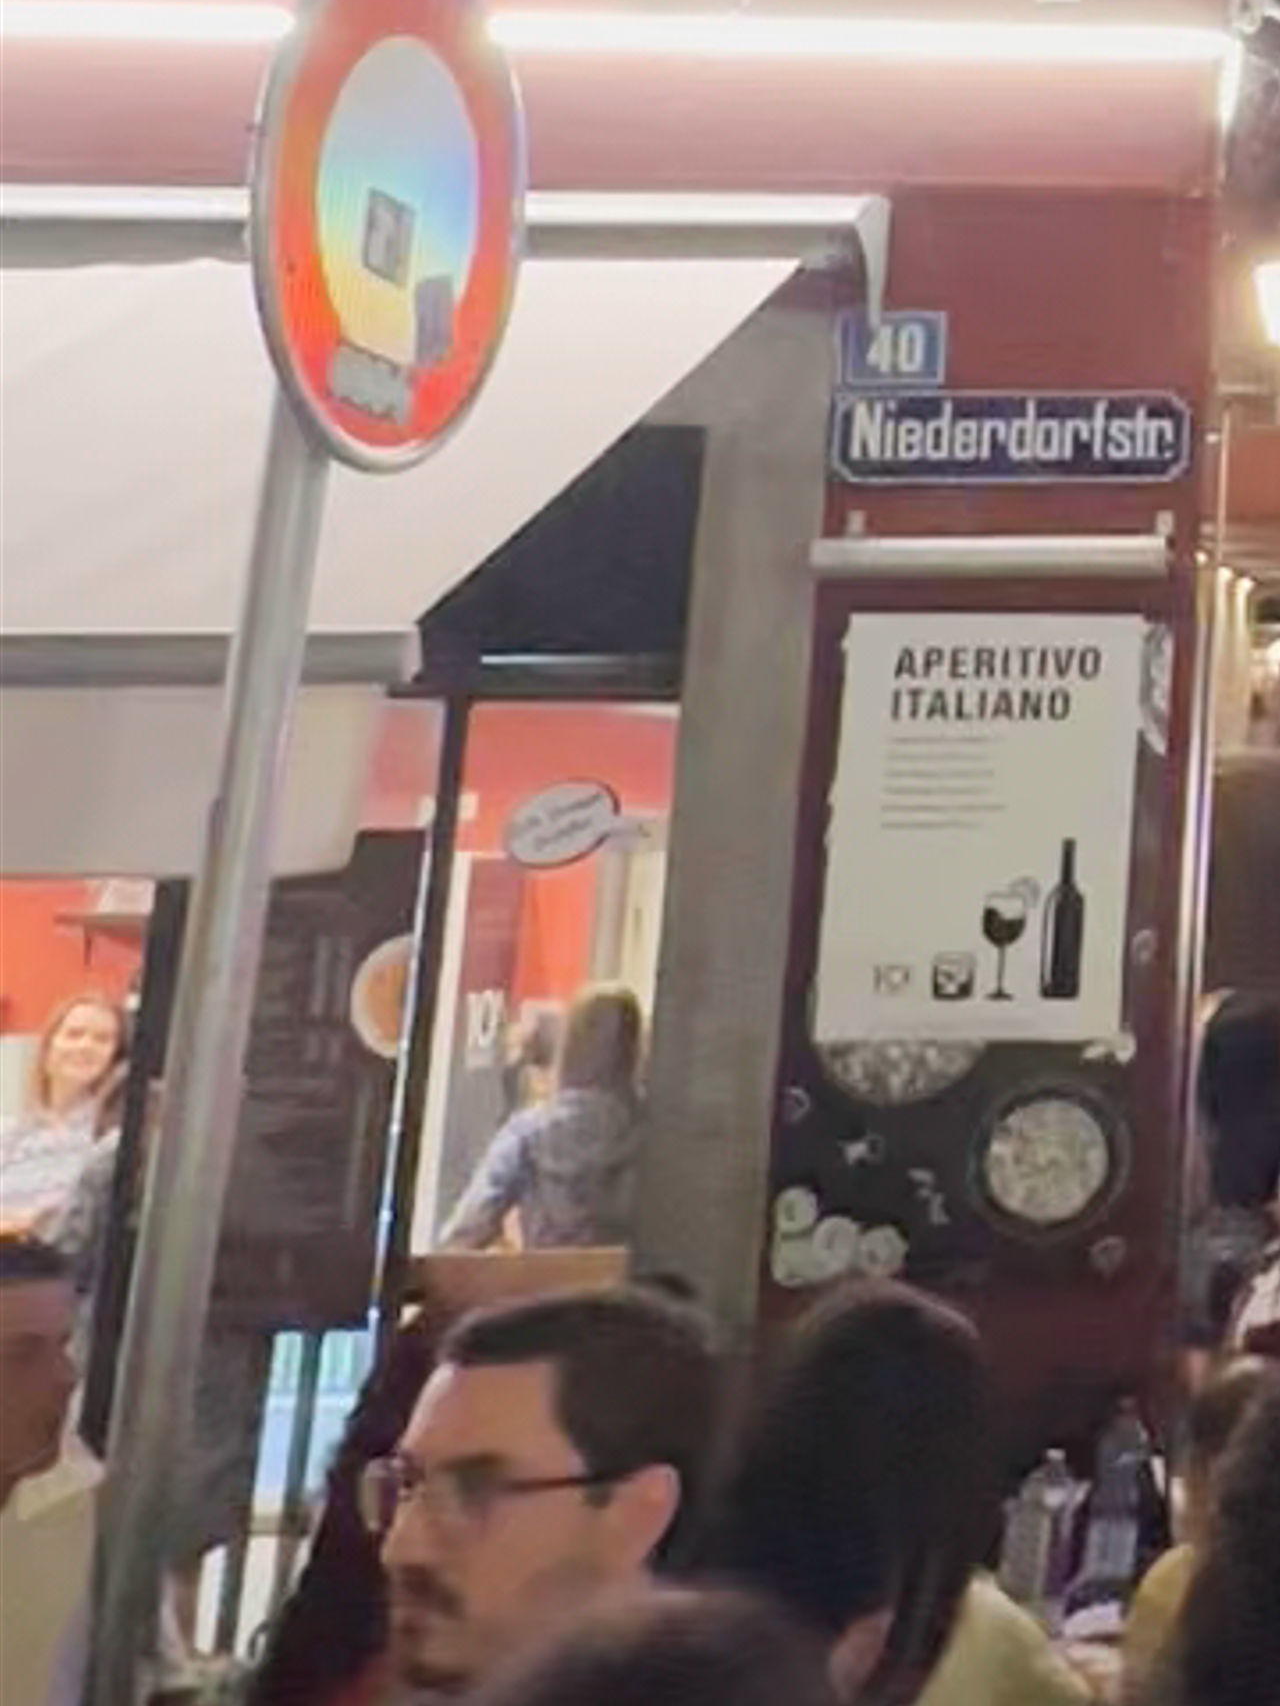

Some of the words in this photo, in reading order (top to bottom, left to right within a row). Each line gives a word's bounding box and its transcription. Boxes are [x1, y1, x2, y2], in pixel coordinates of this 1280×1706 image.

[867, 324, 924, 374] 40
[849, 399, 1174, 461] Niederdorfstr.
[893, 645, 1102, 681] APERITIVO
[890, 687, 1071, 722] ITALIANO
